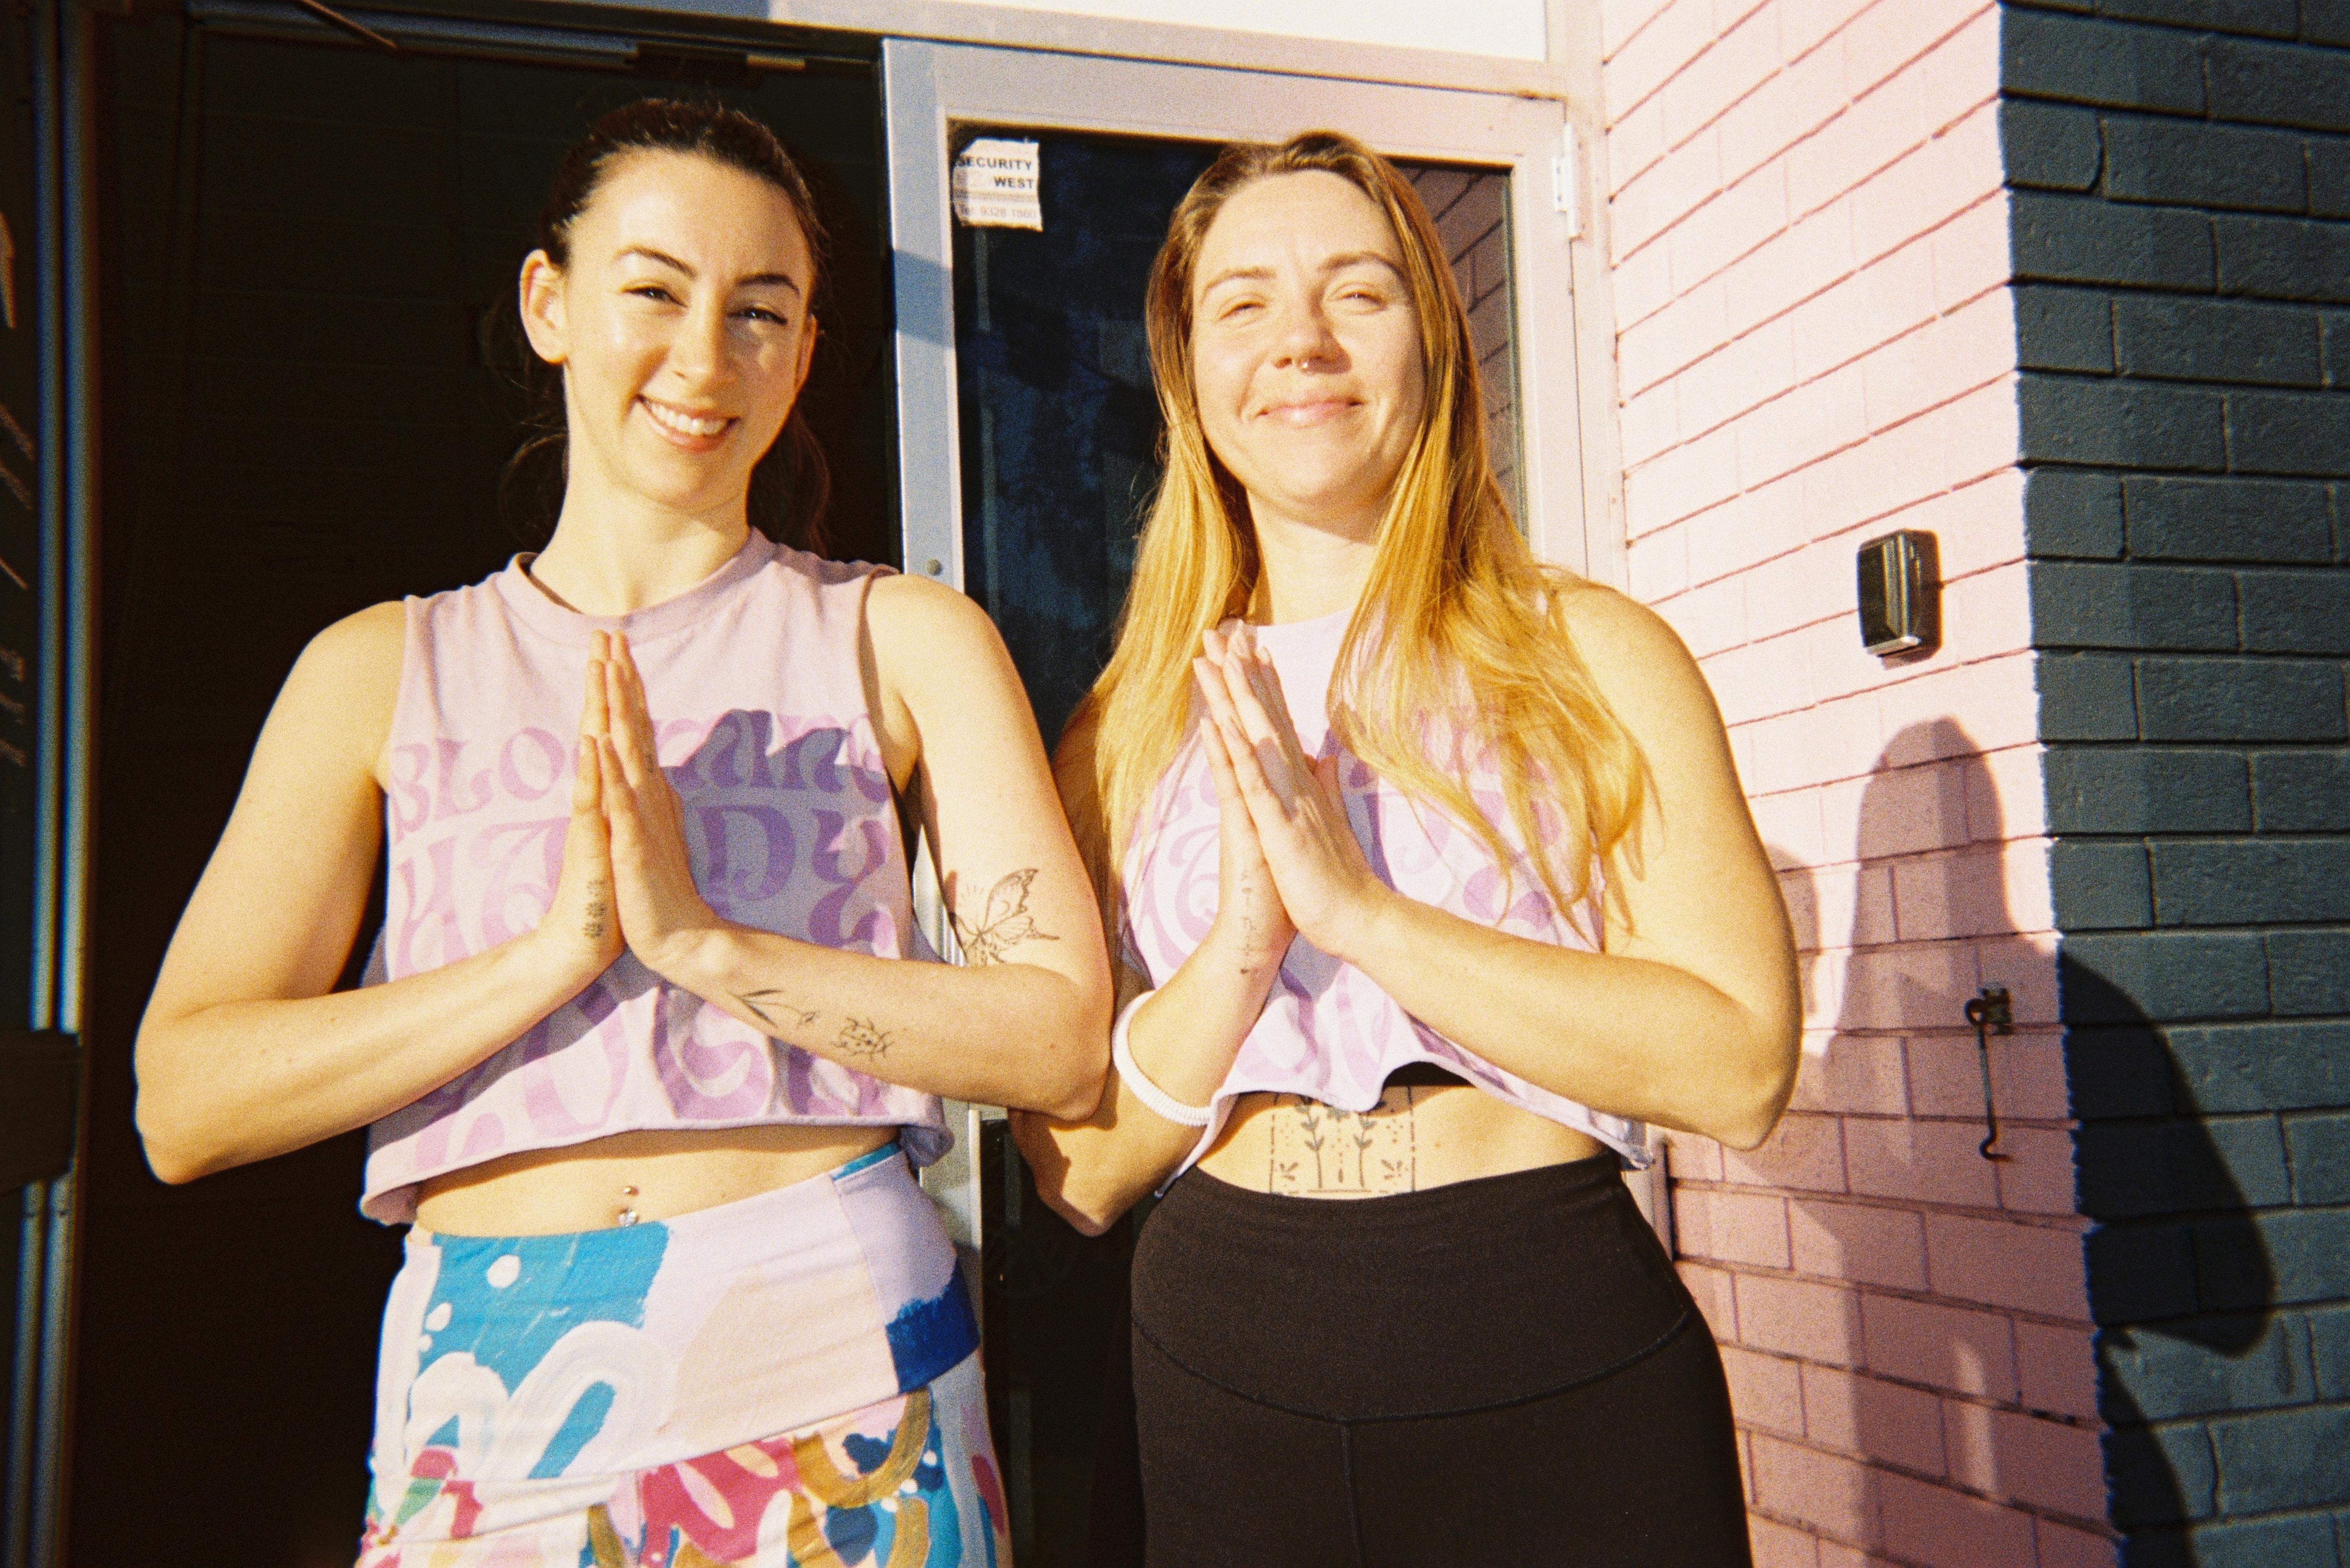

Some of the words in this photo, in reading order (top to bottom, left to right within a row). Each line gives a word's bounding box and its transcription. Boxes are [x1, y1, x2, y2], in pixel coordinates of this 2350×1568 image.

[956, 156, 1032, 171] SECURITY
[994, 175, 1034, 188] WEST
[394, 804, 897, 979] HAPY
